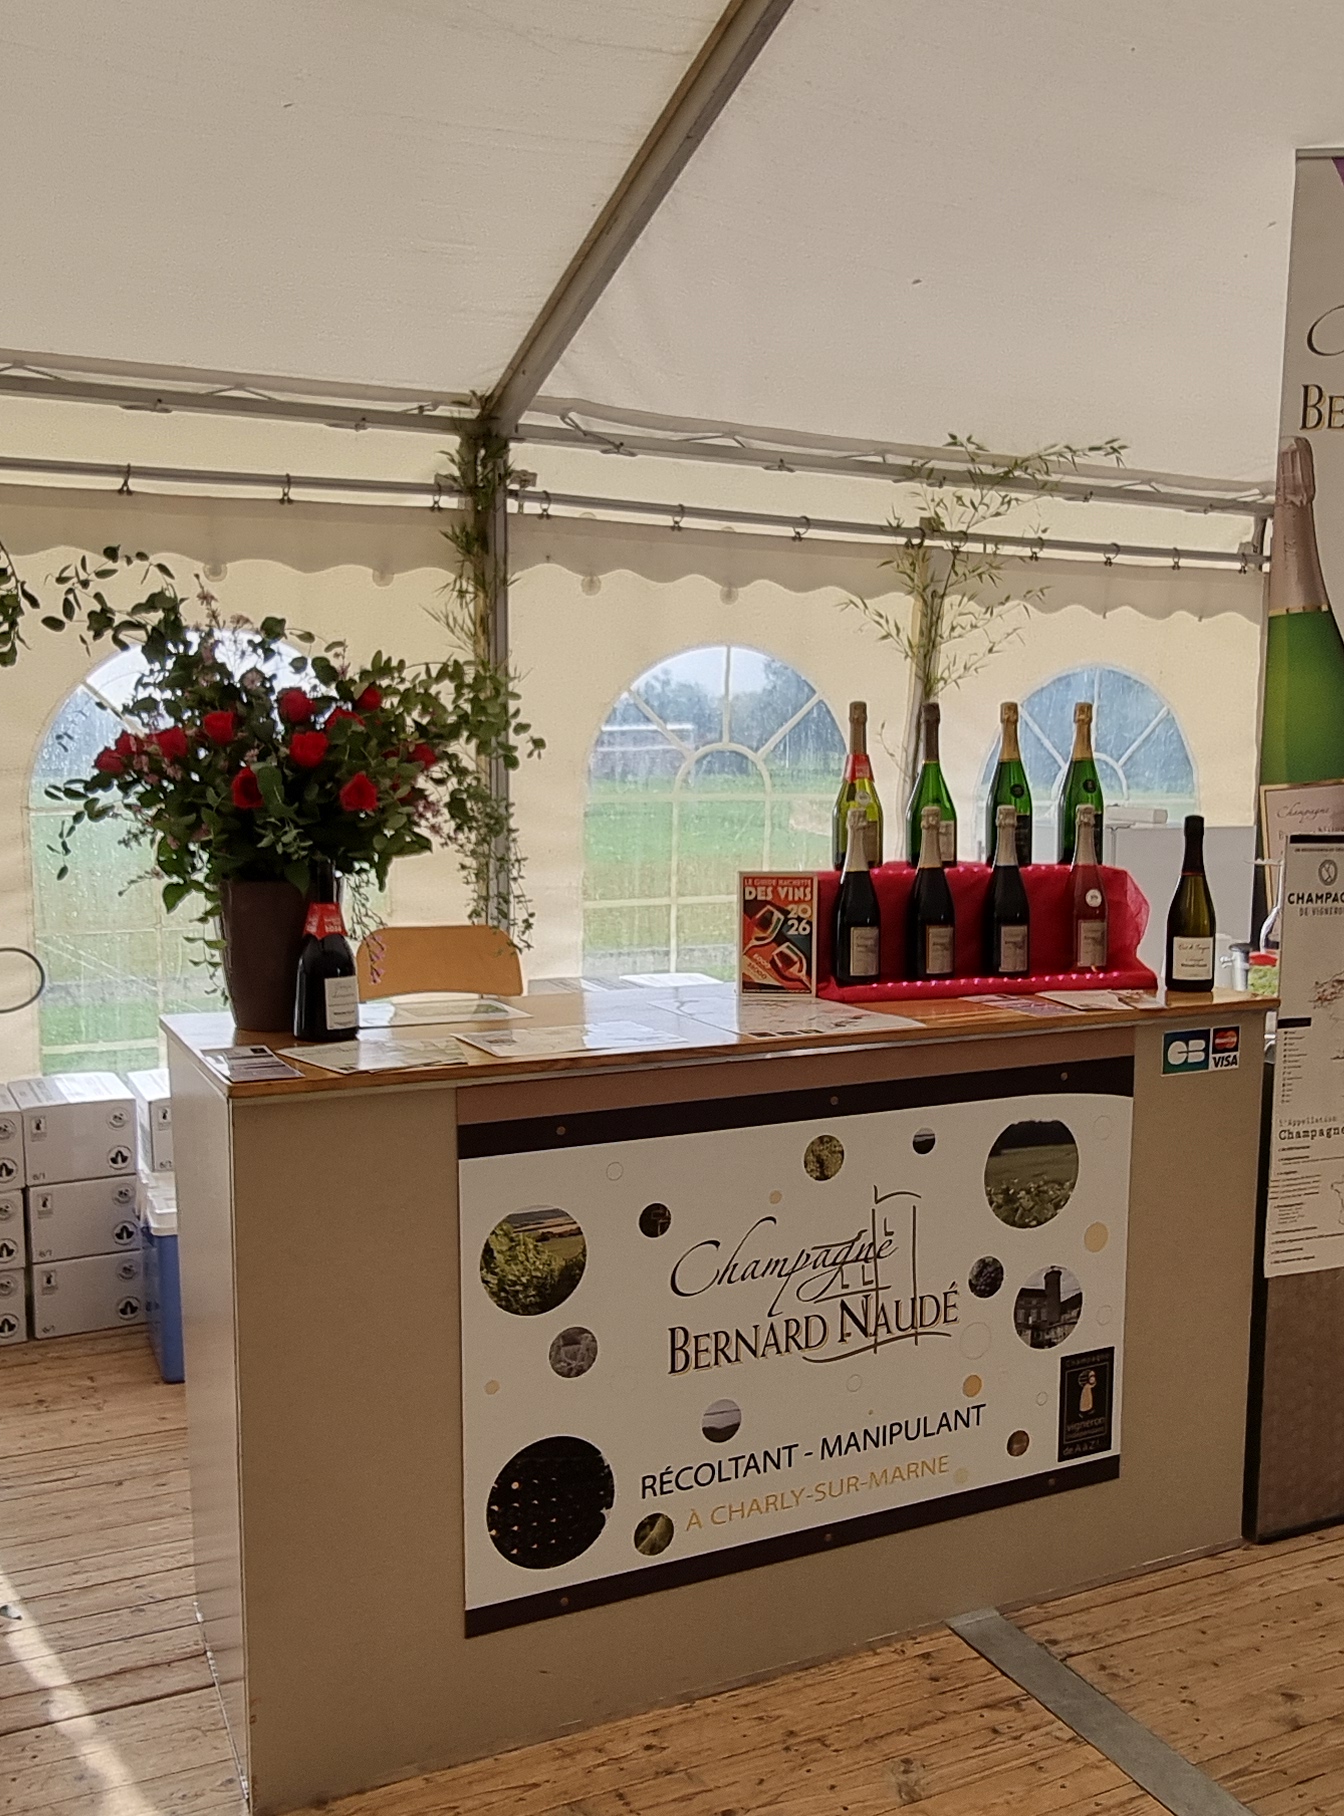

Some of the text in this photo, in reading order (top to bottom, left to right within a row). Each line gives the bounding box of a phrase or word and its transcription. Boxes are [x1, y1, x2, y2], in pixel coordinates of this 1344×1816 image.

[744, 886, 812, 901] DES VINS
[787, 903, 812, 919] 20
[787, 919, 811, 935] 26
[1212, 1055, 1238, 1068] VISA
[668, 1216, 900, 1318] Champagne
[668, 1282, 960, 1377] BERNARD NAUDÉ
[640, 1444, 798, 1500] RÉCOLTANT
[820, 1404, 987, 1460] MANIPULANT
[685, 1455, 950, 1533] À CHARLY-SUR-MARNE
